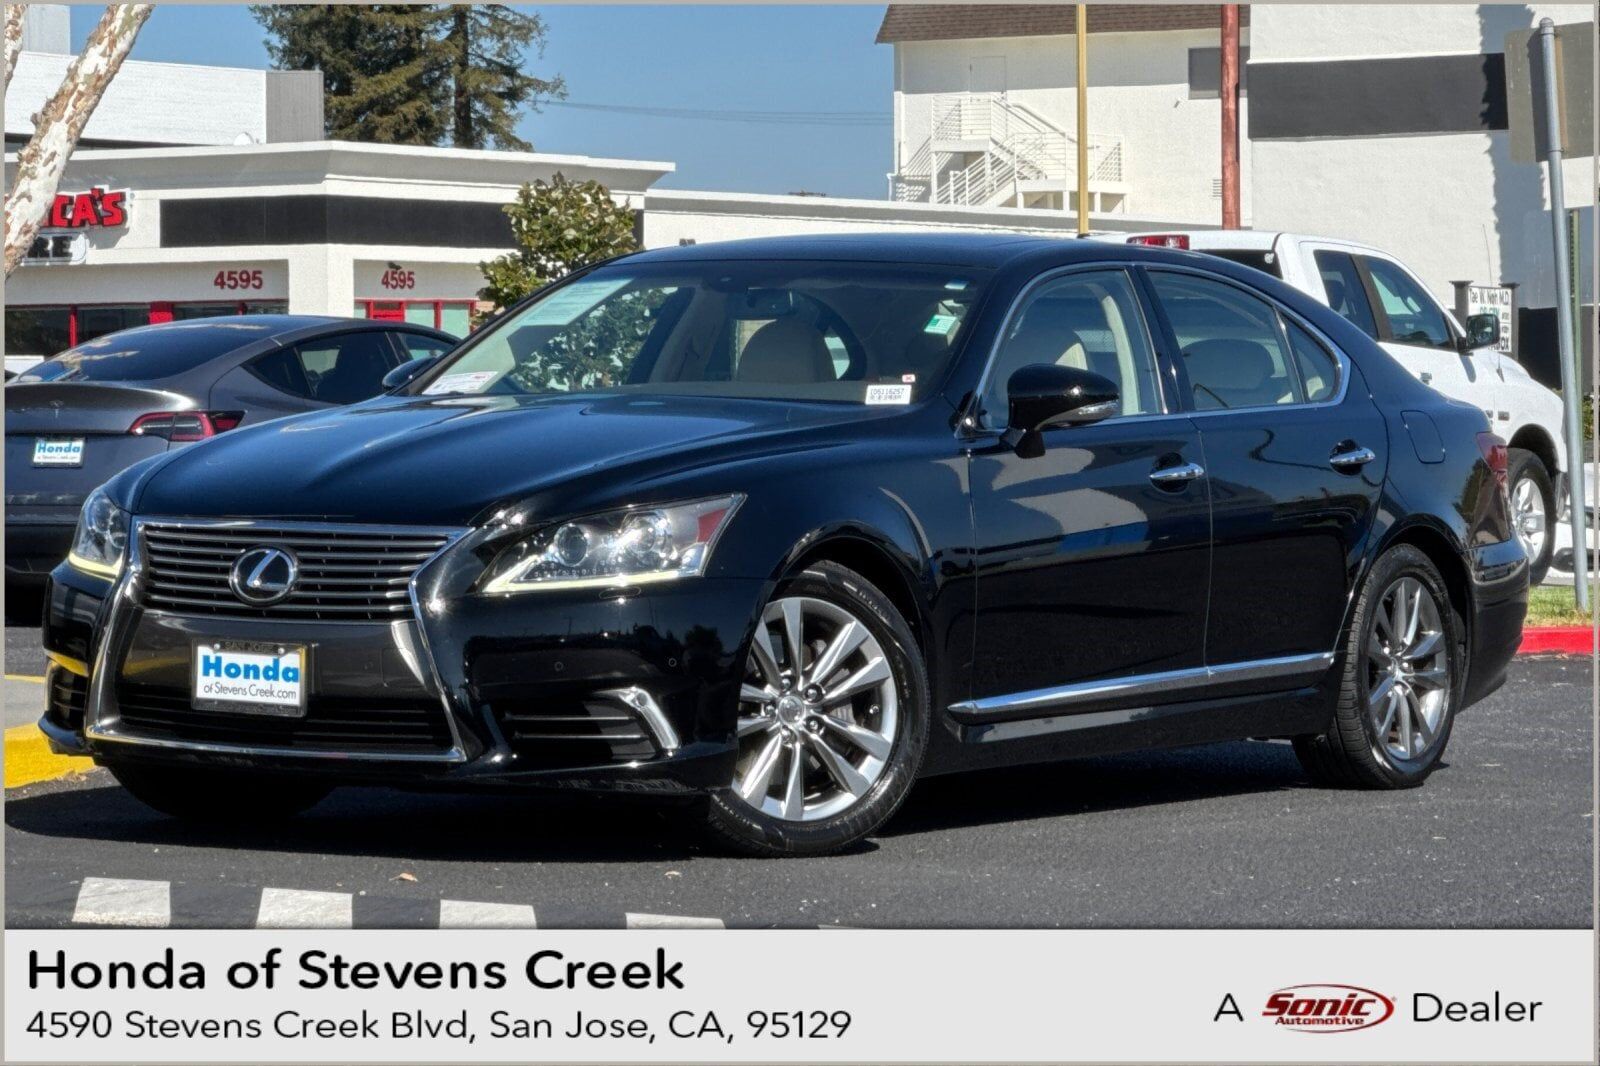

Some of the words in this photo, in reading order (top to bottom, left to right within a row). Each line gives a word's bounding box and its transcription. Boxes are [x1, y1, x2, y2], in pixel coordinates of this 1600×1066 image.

[27, 236, 73, 258] RE
[213, 269, 263, 290] 4595
[381, 269, 415, 290] 4595
[38, 441, 80, 453] Honda
[202, 655, 299, 683] Honda
[204, 684, 213, 694] of
[214, 682, 247, 696] Stevens
[249, 684, 297, 699] Creek.com
